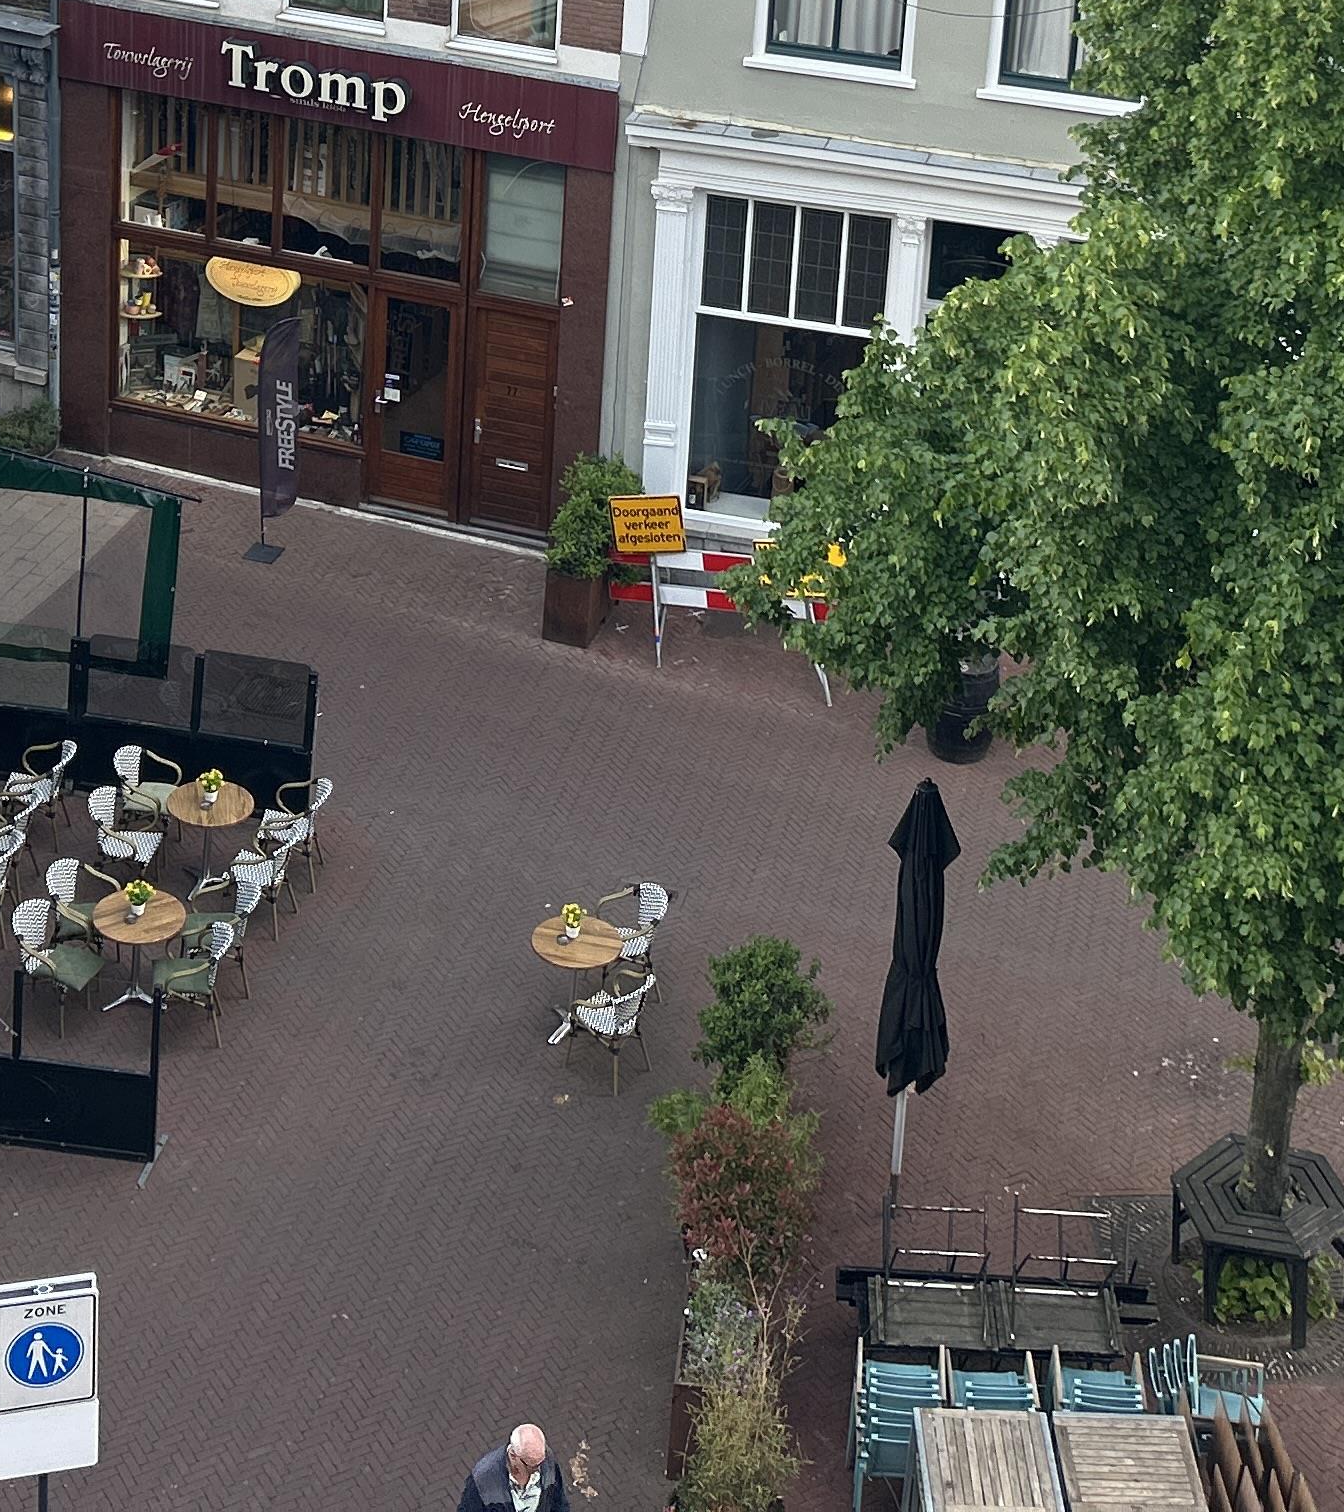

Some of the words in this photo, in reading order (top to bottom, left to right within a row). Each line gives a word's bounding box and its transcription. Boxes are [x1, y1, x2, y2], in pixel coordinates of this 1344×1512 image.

[103, 42, 194, 81] Touwslagerij
[221, 39, 408, 123] Tromp
[458, 101, 556, 139] Hengelsport
[765, 356, 817, 377] BORREL
[274, 379, 296, 471] FREESTYLE
[612, 505, 679, 519] Doorgaand
[624, 519, 670, 530] verkeer
[618, 531, 681, 547] afgesloten
[23, 1303, 67, 1320] ZONE
